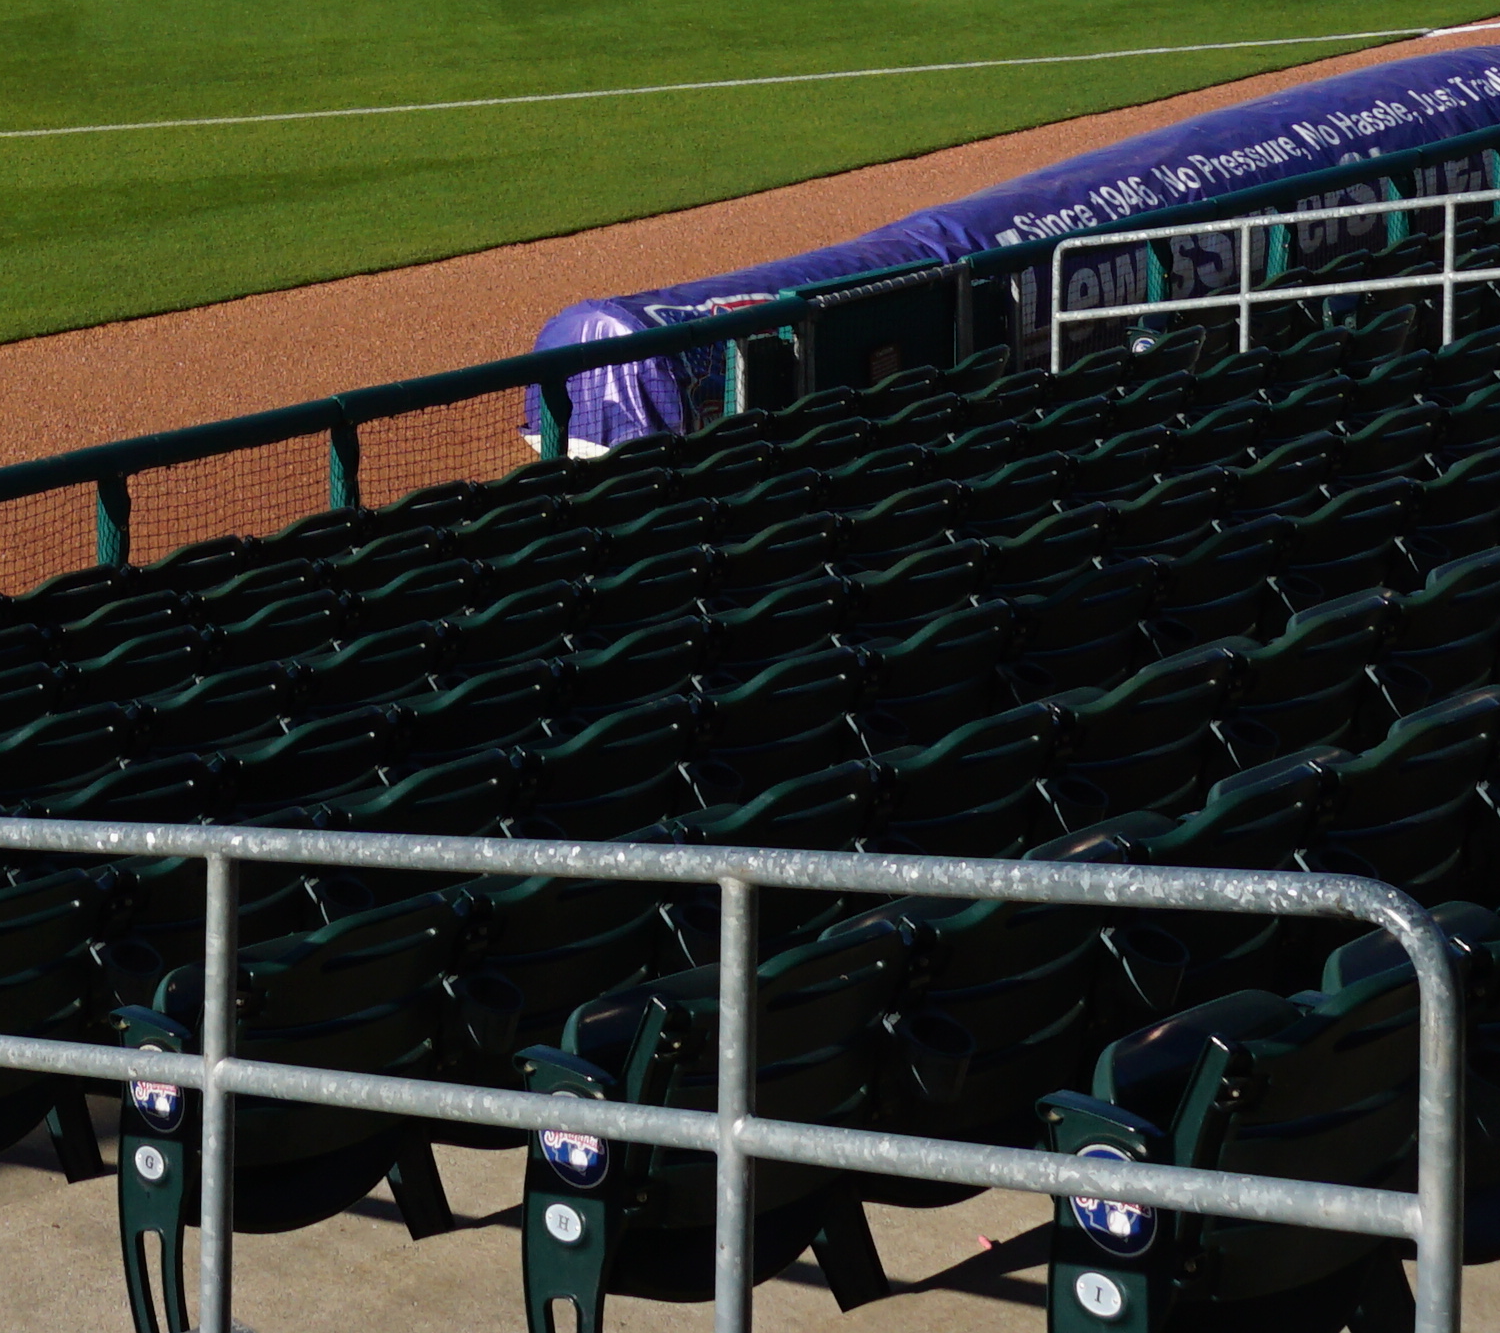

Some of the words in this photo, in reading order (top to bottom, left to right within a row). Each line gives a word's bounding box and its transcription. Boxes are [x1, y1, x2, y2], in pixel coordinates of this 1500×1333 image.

[1013, 203, 1098, 241] Since
[1089, 176, 1168, 221] 1946,
[1151, 164, 1202, 199] No
[1193, 133, 1312, 185] Pressure,
[1291, 120, 1341, 151] No
[1328, 99, 1423, 140] Hassle,
[1408, 85, 1458, 116] Just
[145, 1155, 154, 1169] G
[559, 1215, 570, 1232] H
[1093, 1286, 1103, 1304] I
